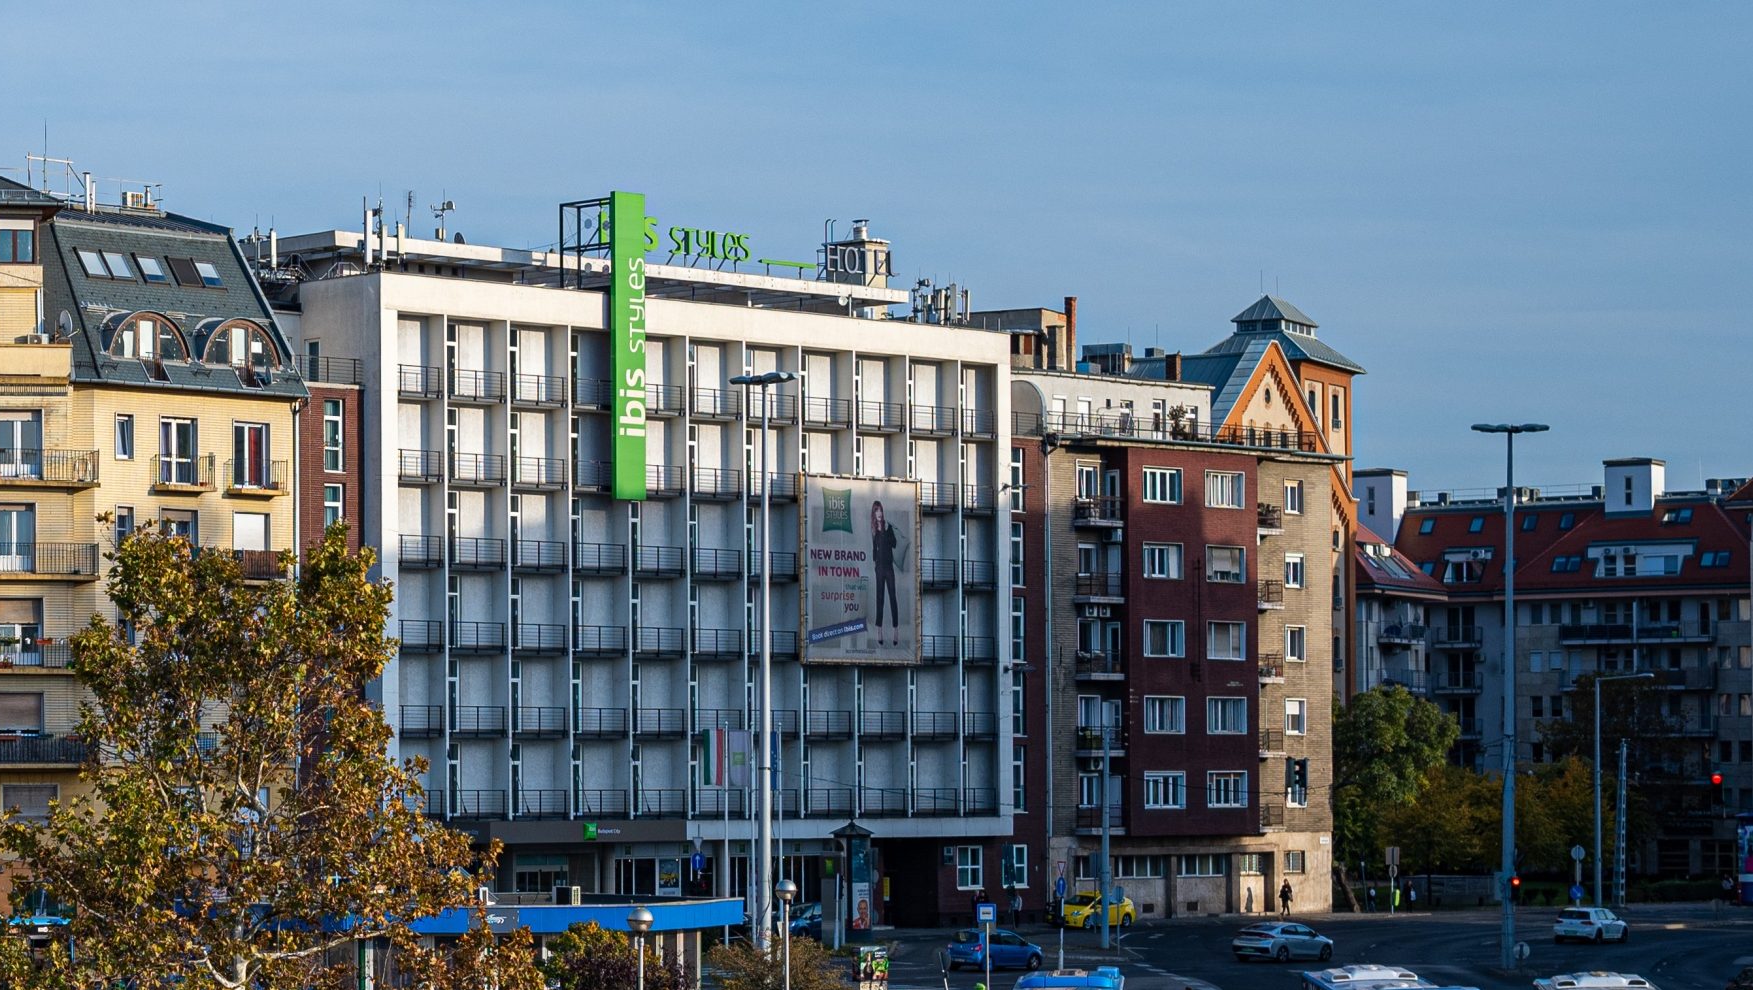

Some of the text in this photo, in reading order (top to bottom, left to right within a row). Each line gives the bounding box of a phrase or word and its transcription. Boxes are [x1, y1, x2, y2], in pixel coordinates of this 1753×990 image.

[827, 243, 895, 278] HOTEL
[619, 369, 645, 437] ibis
[828, 496, 845, 510] ibis
[810, 549, 866, 562] NEW BRAND
[818, 566, 860, 578] IN TOWN
[821, 591, 855, 602] surprise
[844, 603, 859, 613] you
